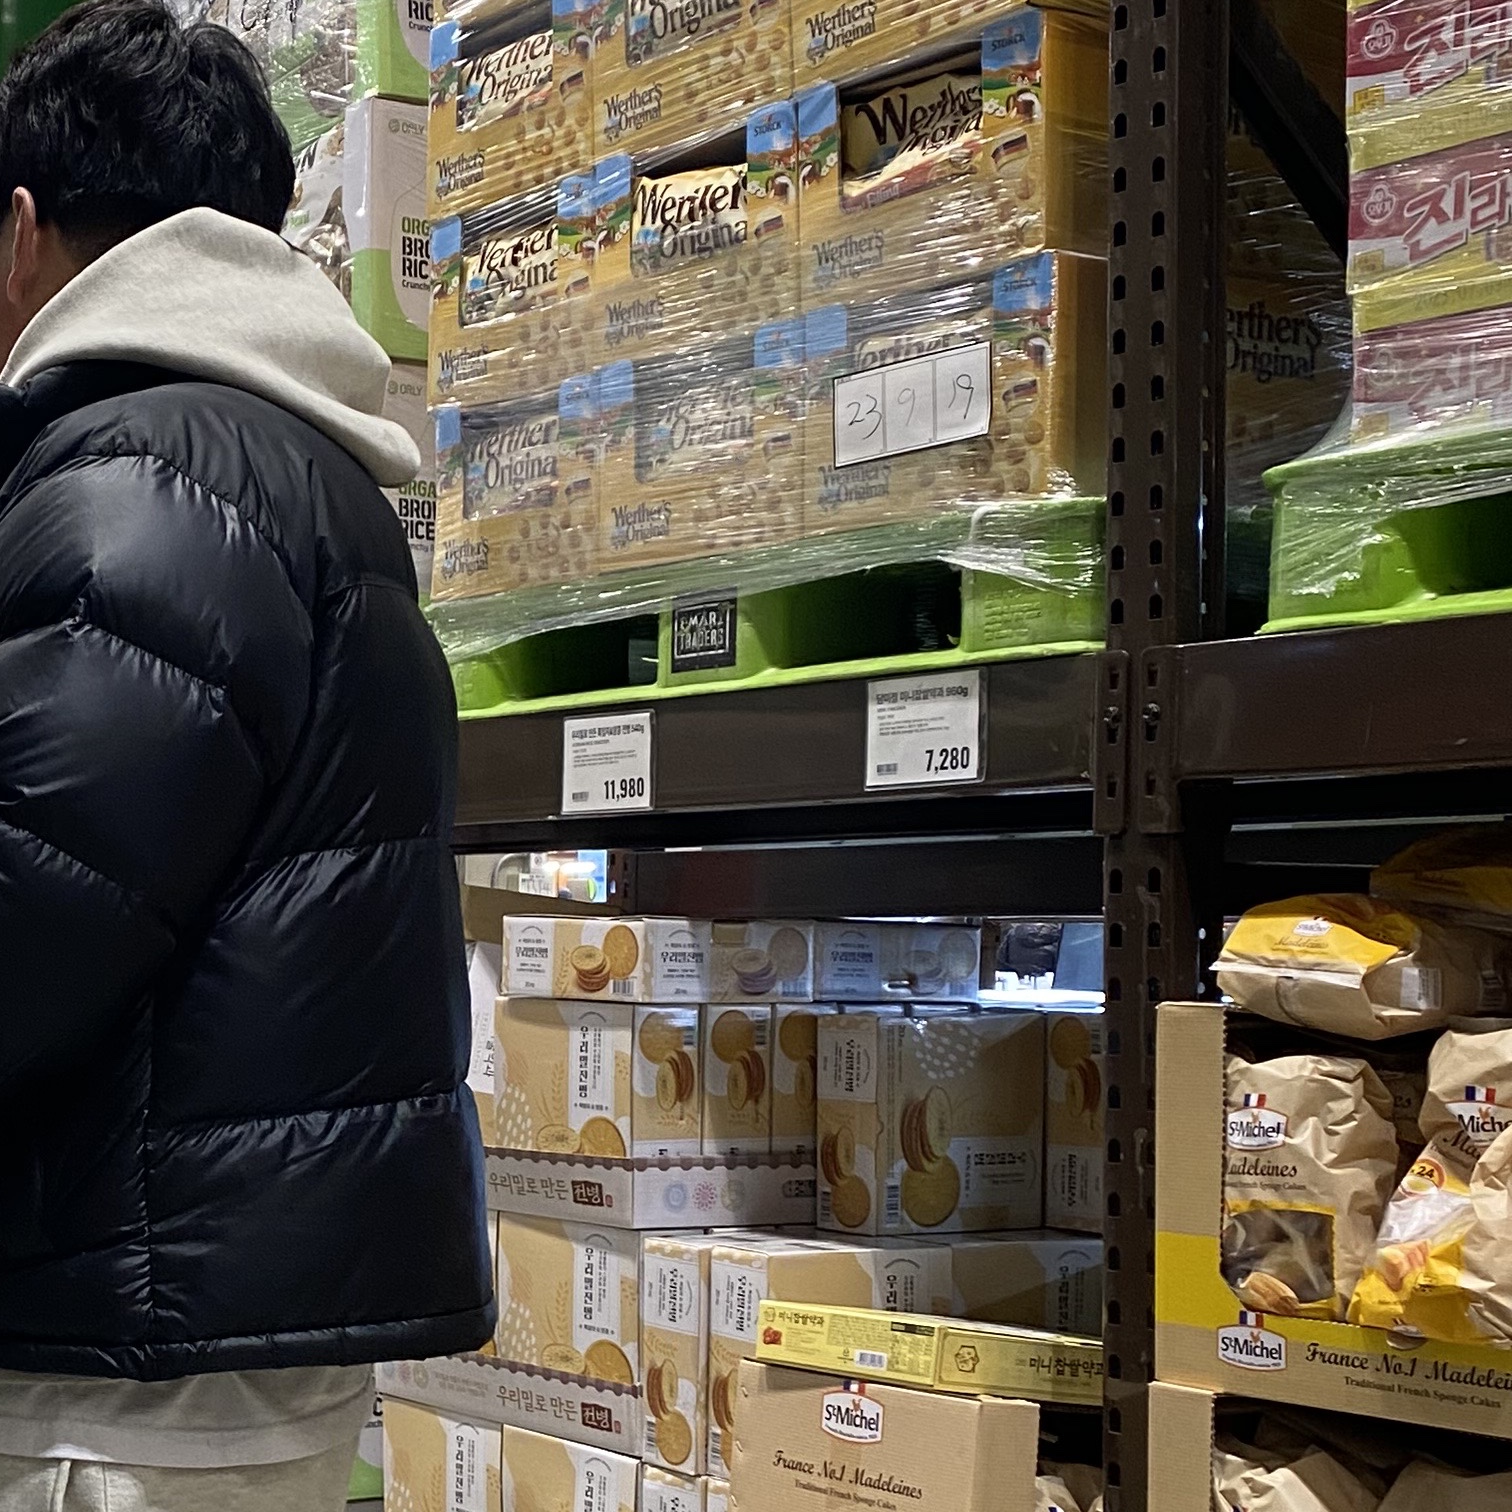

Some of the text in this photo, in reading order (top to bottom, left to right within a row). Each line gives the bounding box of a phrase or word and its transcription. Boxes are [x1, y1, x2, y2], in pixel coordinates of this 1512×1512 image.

[824, 17, 877, 51] Original
[604, 82, 663, 118] Werther's
[618, 104, 663, 132] Original
[435, 148, 485, 182] Werther's
[399, 383, 424, 397] ORLY
[845, 373, 975, 441] 23 9 19
[925, 746, 970, 775] 7,280
[604, 776, 645, 803] 11,980
[488, 1171, 604, 1206] 우리밀로 만든 전병
[1306, 1342, 1512, 1391] France No.1 Madelei
[495, 1384, 612, 1431] 우리밀로 만든 전병
[772, 1449, 923, 1500] France No.1 Madeleines
